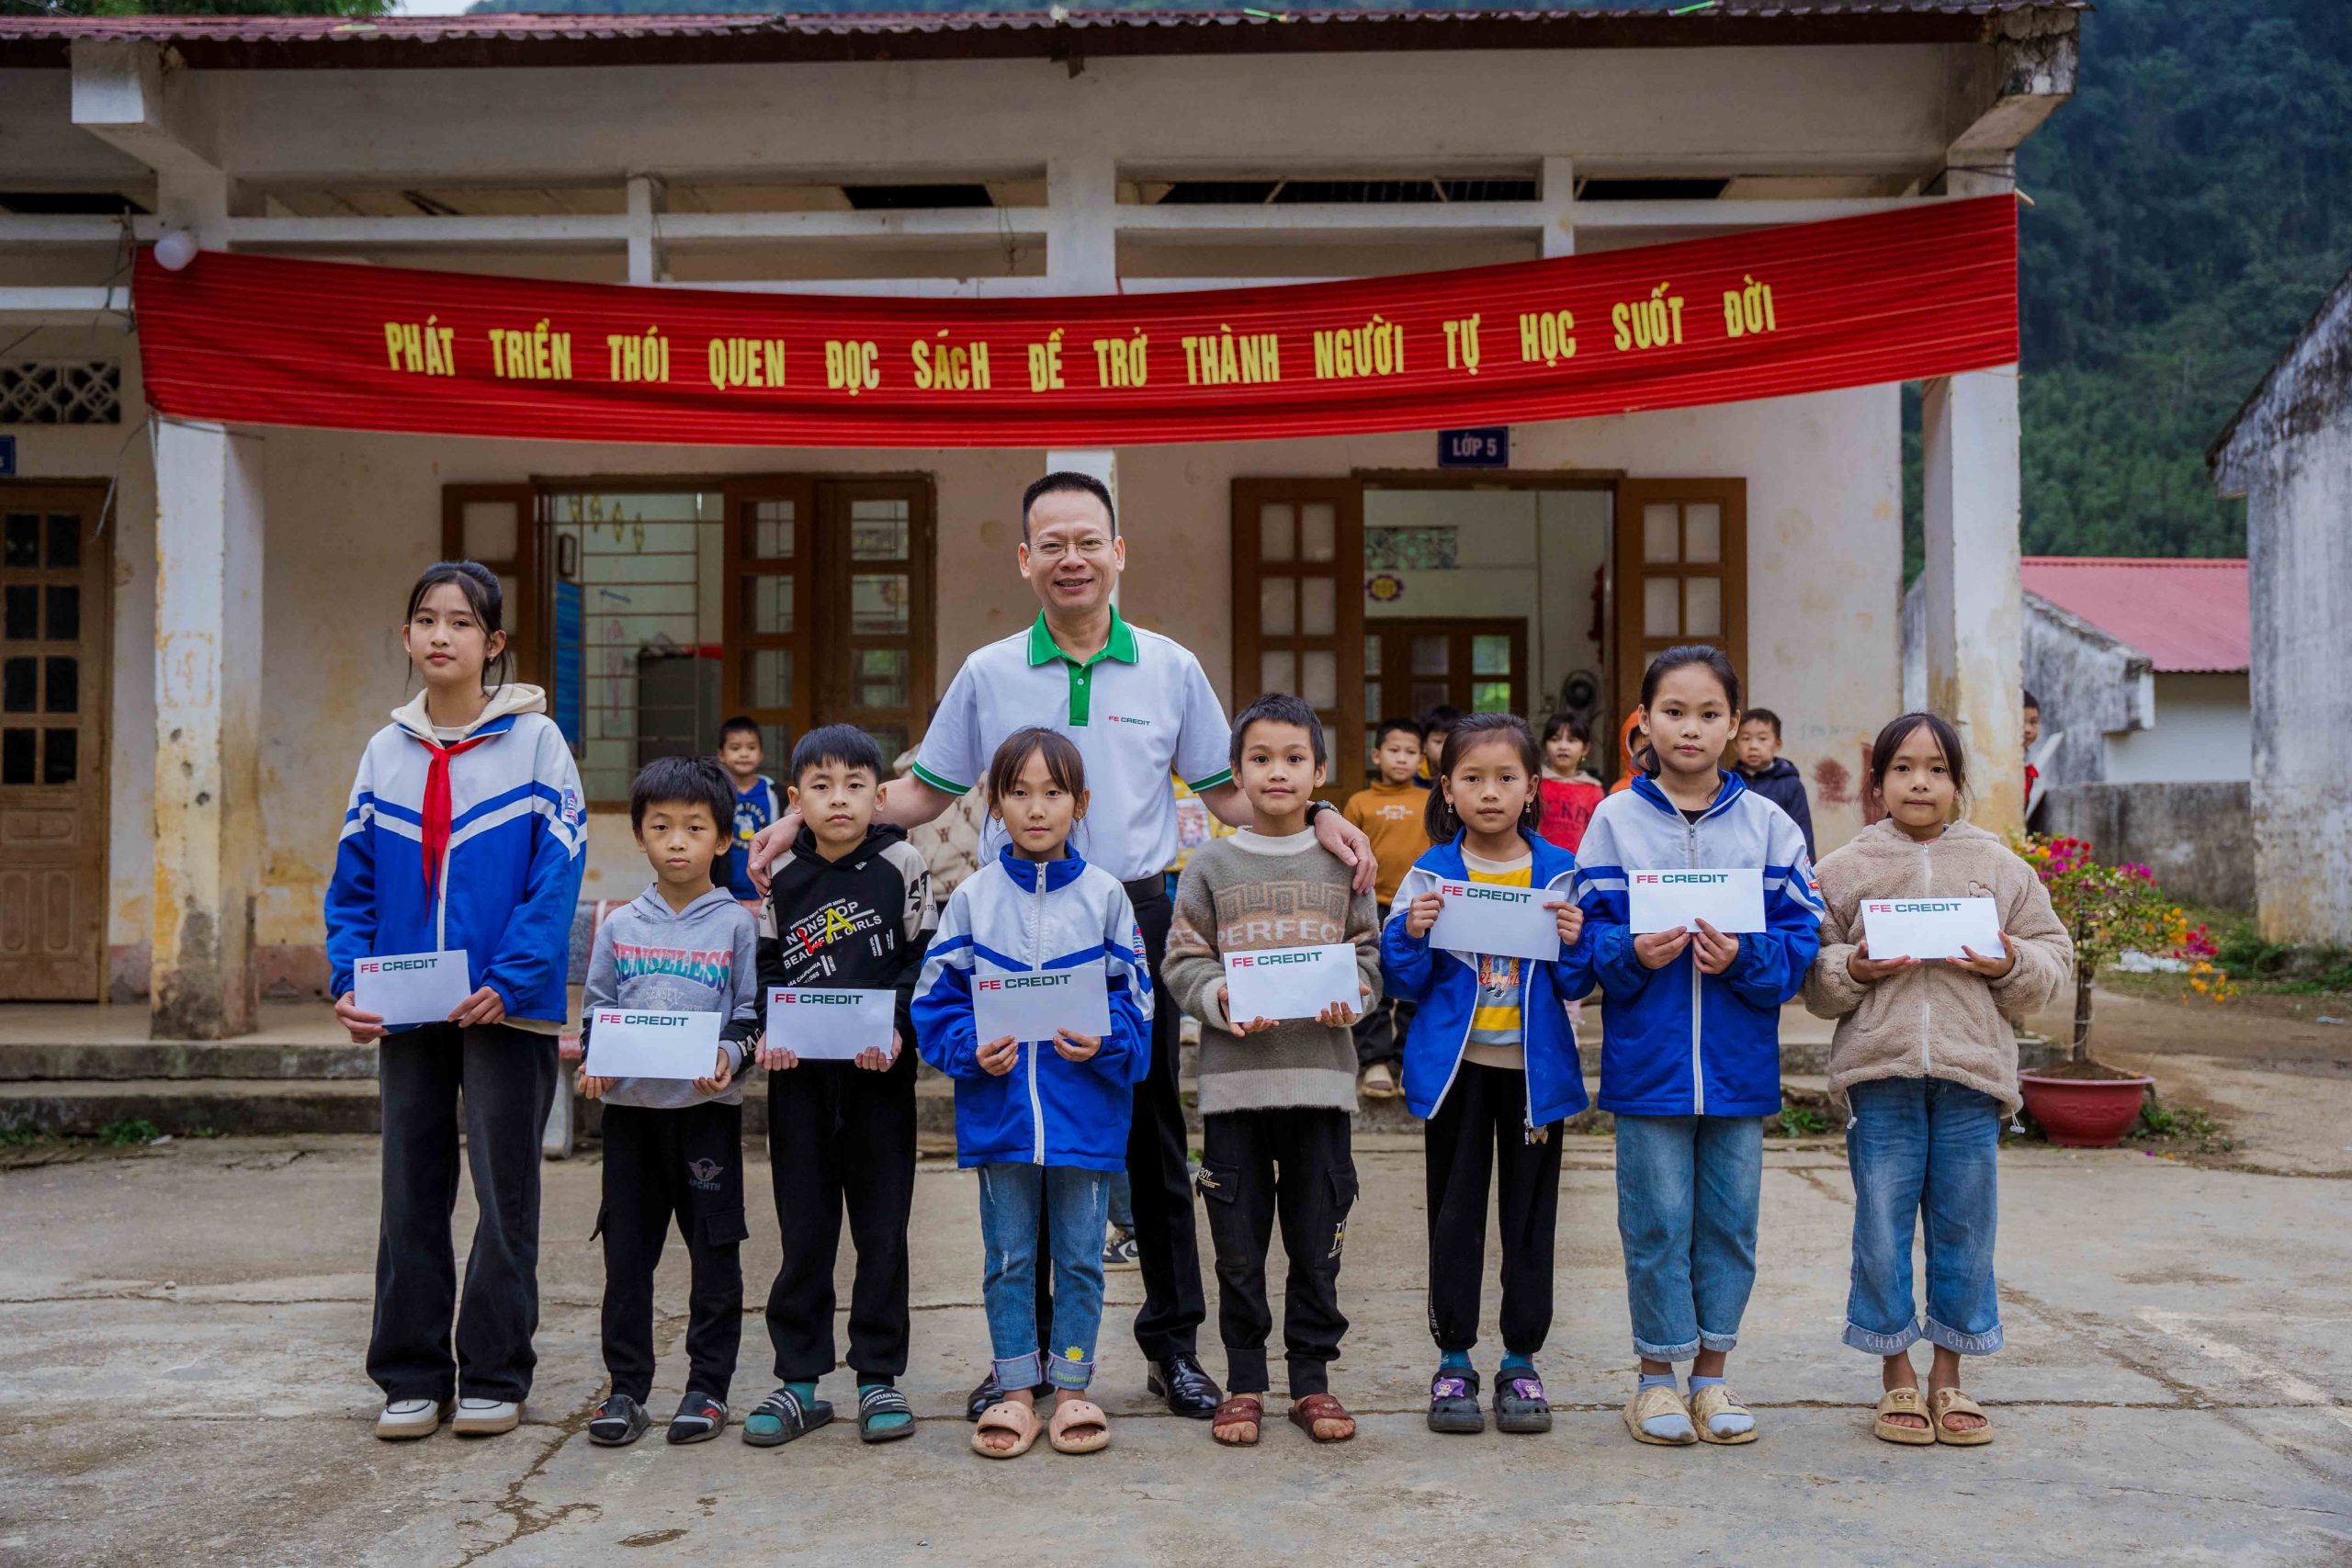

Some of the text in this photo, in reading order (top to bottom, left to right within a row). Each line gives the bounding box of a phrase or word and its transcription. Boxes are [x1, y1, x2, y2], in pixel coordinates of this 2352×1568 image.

[385, 275, 1776, 396] PHÁT TRIỂN THÓI QUEN ĐỌC SÁCH ĐỂ TRỞ THÀNH NGƯỜI TỰ HỌC SUỐT ĐỜI
[1453, 432, 1498, 457] LỚP 5
[1120, 716, 1151, 727] CREDIT
[1636, 874, 1729, 884] FE CREDIT
[1442, 885, 1532, 904] FE CREDIT
[1869, 903, 1962, 913] FE CREDIT
[1218, 919, 1345, 947] ERFEC
[783, 931, 842, 970] BEAUFUL
[361, 958, 438, 974] FE CREDIT
[1232, 951, 1323, 968] FE CREDIT
[978, 974, 1072, 991] FE CREDIT
[775, 993, 864, 1005] FE CREDIT
[599, 1014, 689, 1027] FE CREDIT
[1947, 1330, 1999, 1351] CHANEL
